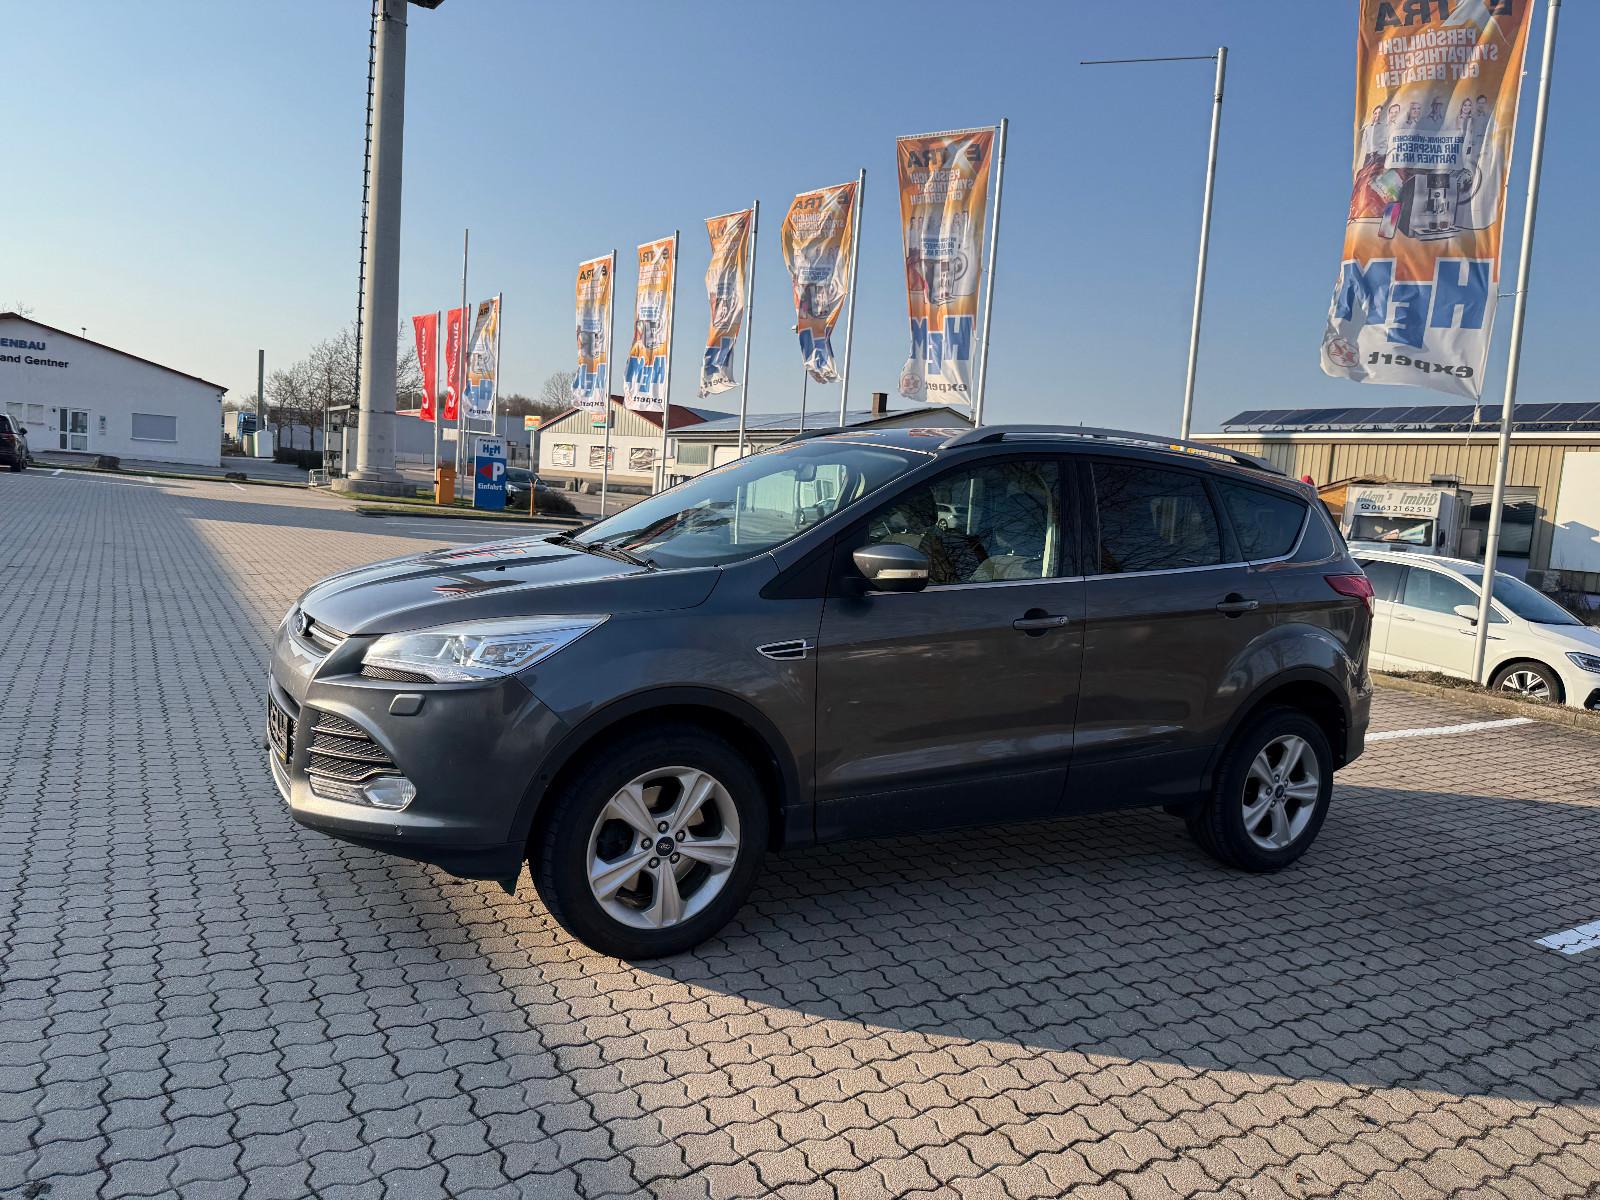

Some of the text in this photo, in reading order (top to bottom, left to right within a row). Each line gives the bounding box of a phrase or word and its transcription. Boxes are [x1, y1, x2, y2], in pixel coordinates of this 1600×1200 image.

[0, 338, 45, 350] ENBAU
[24, 355, 69, 368] Gentner
[482, 444, 501, 456] HEM
[493, 462, 505, 481] P
[478, 482, 503, 491] Einfahrt
